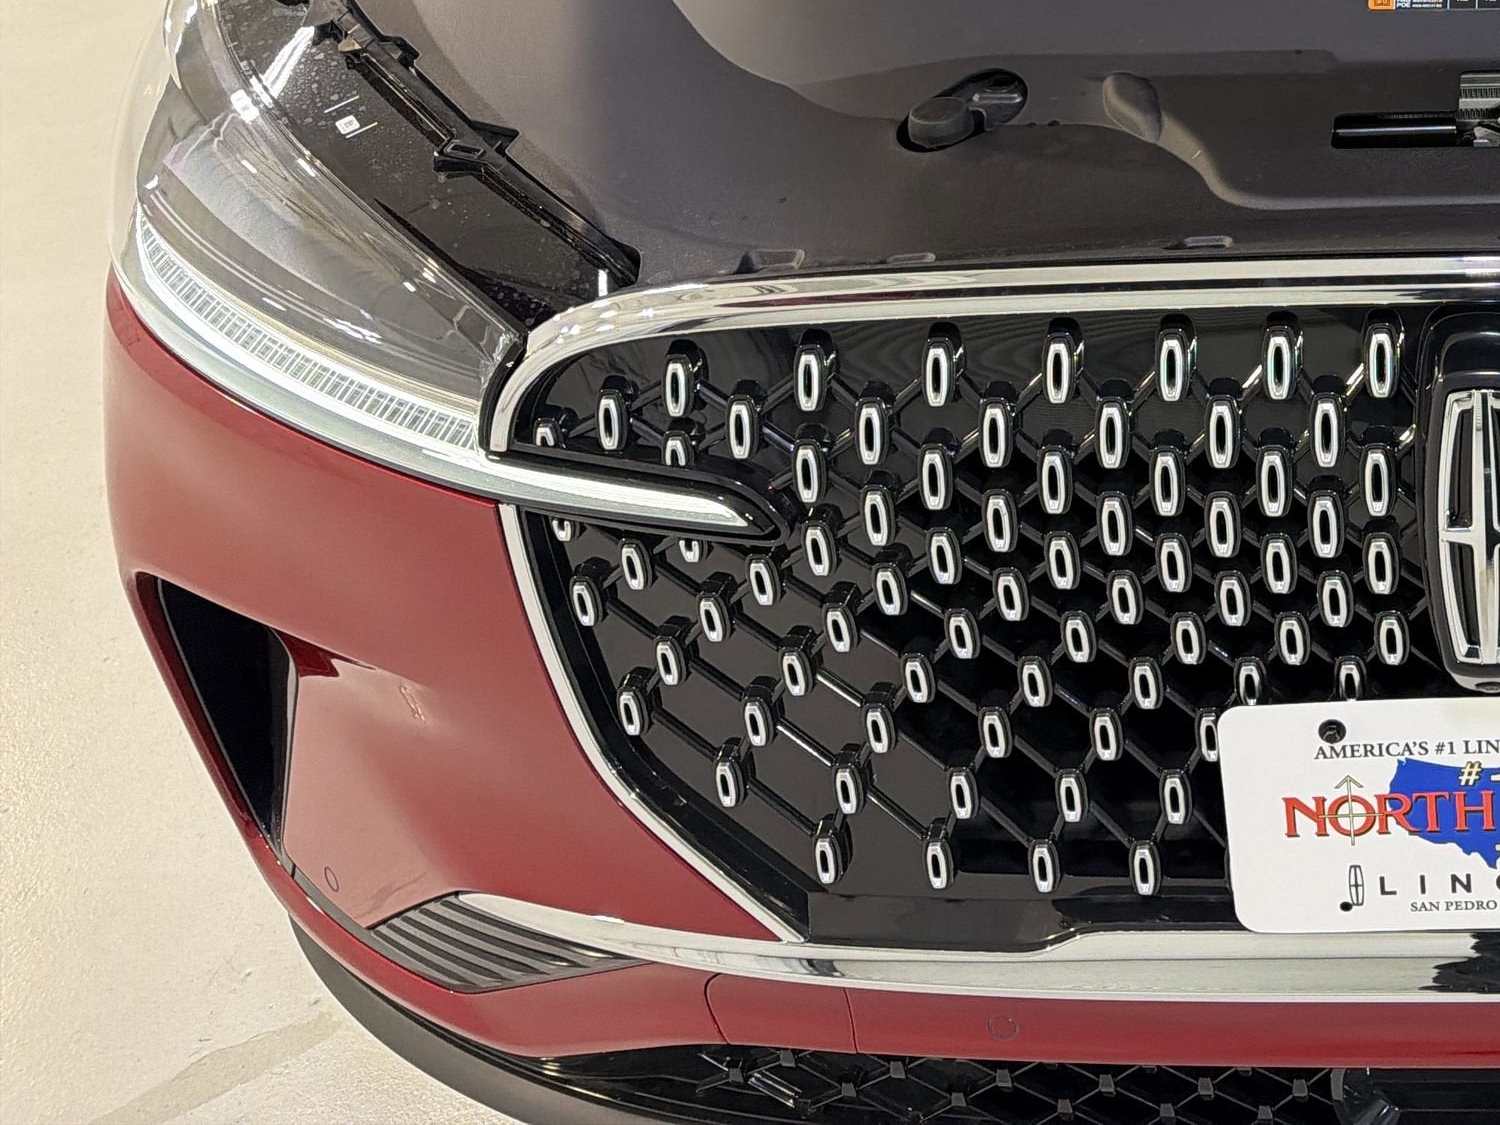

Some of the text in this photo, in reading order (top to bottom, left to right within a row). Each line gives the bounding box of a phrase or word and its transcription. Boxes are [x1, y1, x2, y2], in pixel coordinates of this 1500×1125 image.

[1314, 740, 1429, 760] AMERICA'S
[1435, 741, 1457, 755] #1
[1281, 789, 1496, 839] NORTH
[1410, 901, 1440, 912] SAN
[1444, 900, 1498, 912] PEDRO
